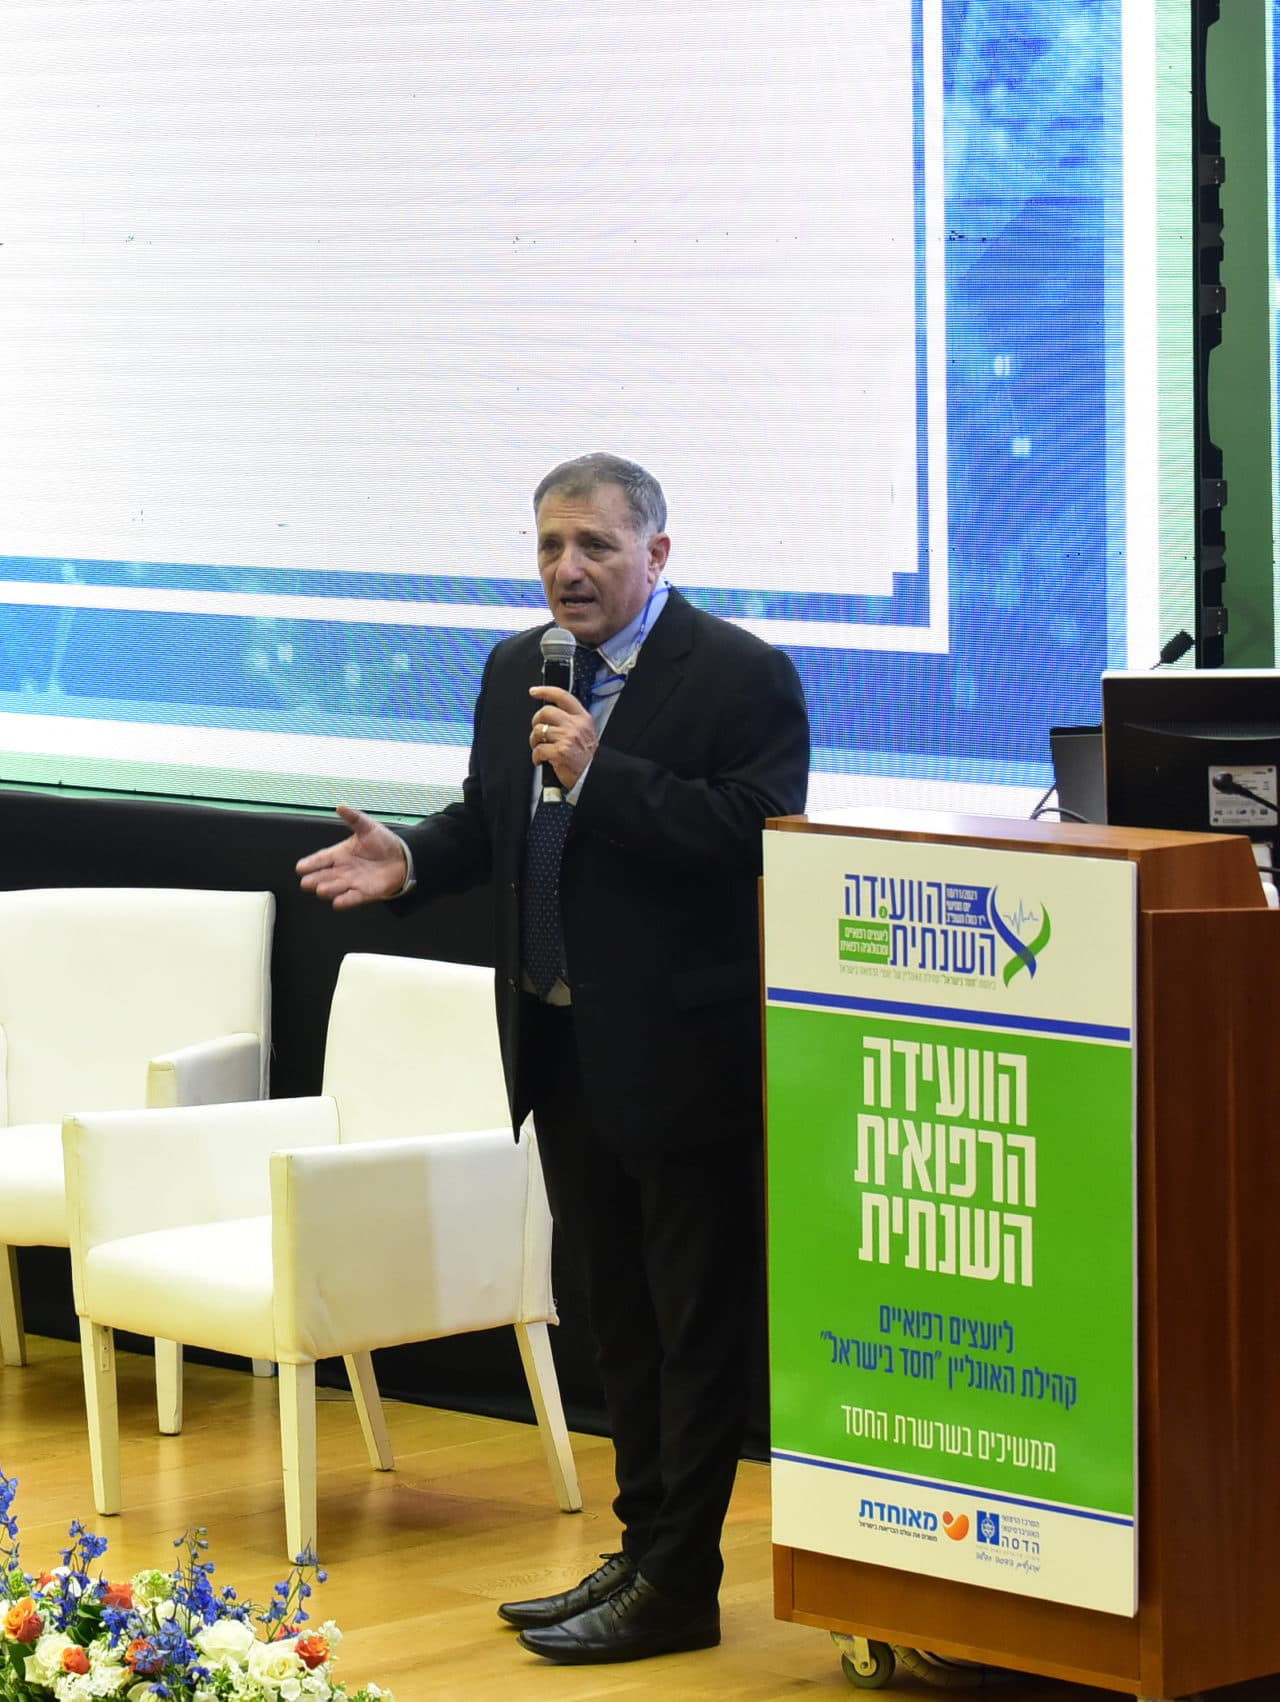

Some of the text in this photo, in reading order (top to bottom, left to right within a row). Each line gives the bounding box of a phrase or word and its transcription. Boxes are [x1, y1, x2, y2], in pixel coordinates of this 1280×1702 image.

[844, 873, 942, 925] הוועידה
[890, 924, 995, 977] השנתית
[863, 1036, 1027, 1127] הוועידה
[854, 1113, 1036, 1208] הרפואית
[858, 1191, 1033, 1287] השנתית
[879, 1304, 1014, 1354] ליועצים רפואיים
[948, 1354, 1016, 1394] האונליין
[1021, 1366, 1077, 1411] קהילת
[841, 1405, 1056, 1473] ממשיכים בשרשרת החסד
[859, 1498, 938, 1532] מאוחדת
[1001, 1535, 1040, 1555] הדסה
